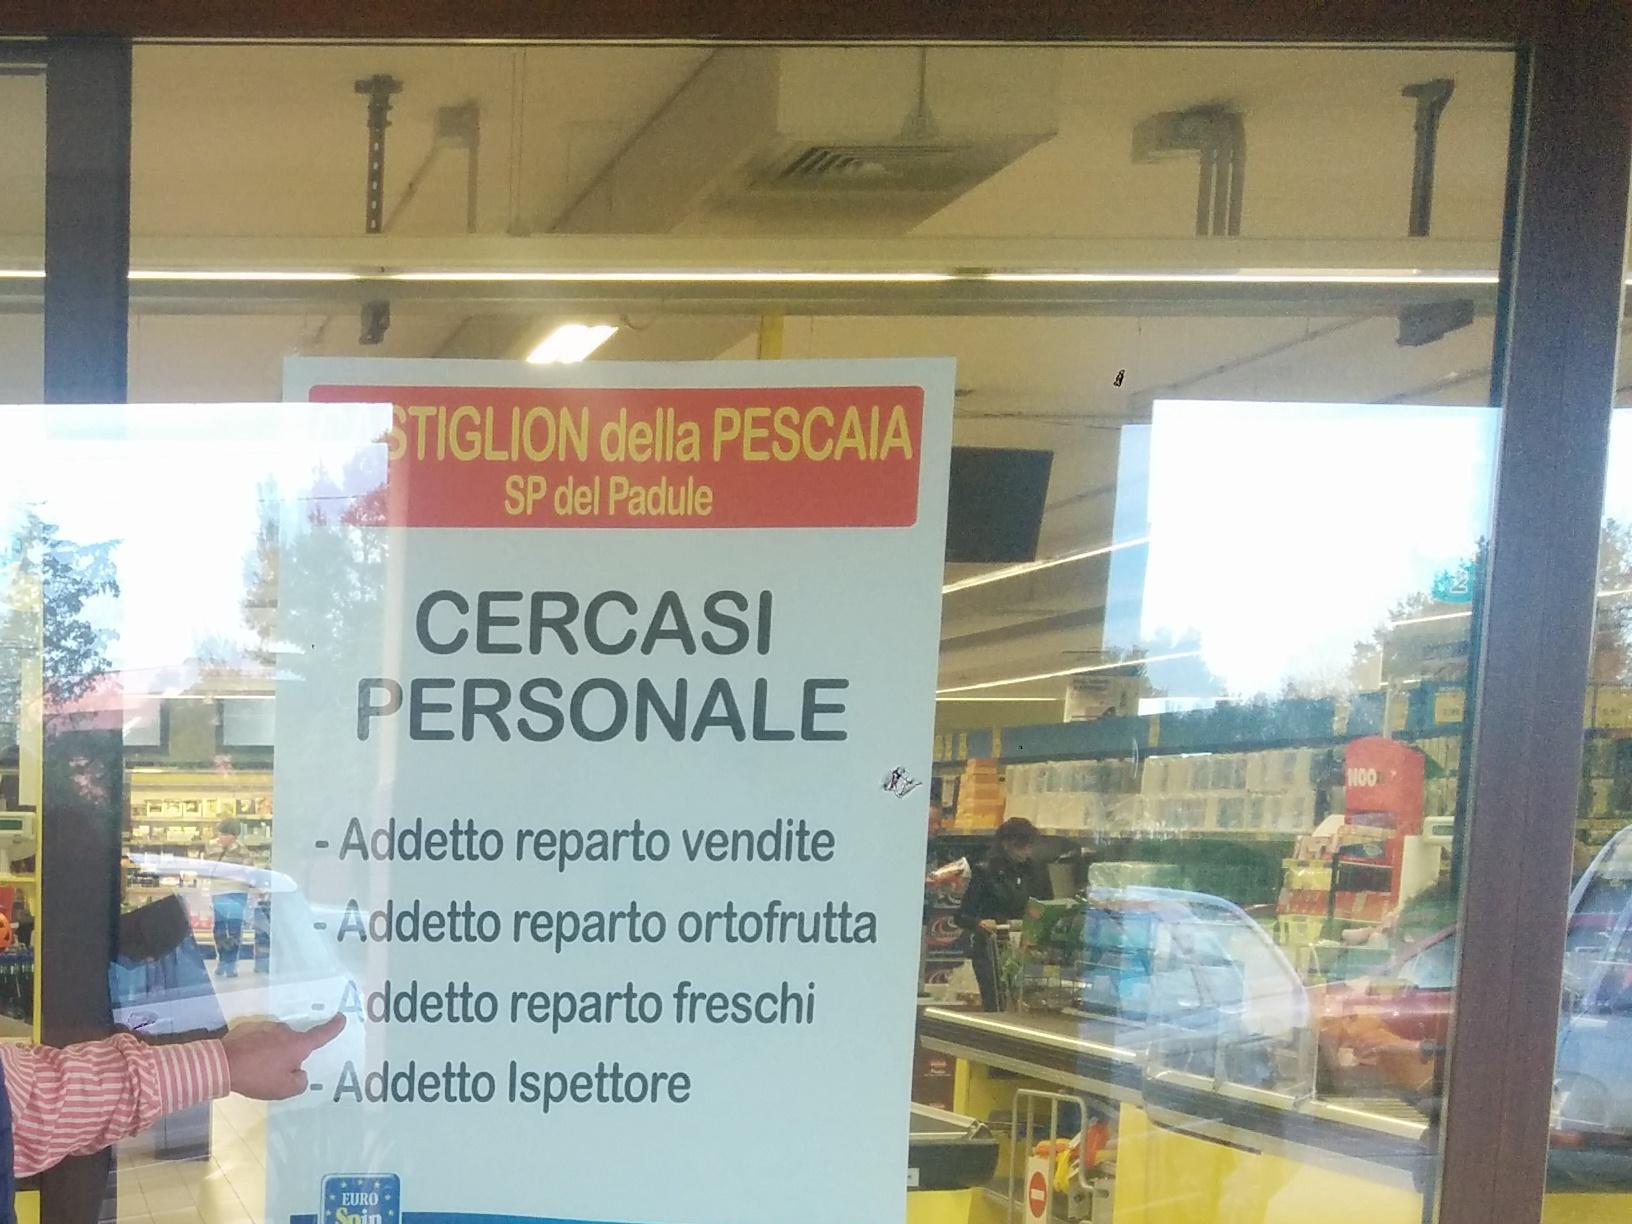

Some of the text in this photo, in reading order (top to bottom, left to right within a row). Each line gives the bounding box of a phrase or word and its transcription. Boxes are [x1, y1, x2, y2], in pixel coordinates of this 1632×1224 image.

[389, 404, 913, 463] STIGLION della PESCAIA
[504, 475, 714, 517] SP del Padule
[415, 589, 773, 656] CERCASI
[356, 676, 850, 742] PERSONALE
[338, 817, 504, 863] Addetto
[515, 821, 670, 872] reparto
[682, 818, 836, 864] vendite
[336, 899, 501, 945] Addetto
[512, 902, 667, 953] reparto
[678, 900, 879, 946] ortofrutta
[337, 980, 498, 1023] Addetto
[509, 983, 664, 1033] reparto
[673, 981, 816, 1025] freschi
[333, 1060, 496, 1104] Addetto
[508, 1060, 691, 1112] Ispettore
[342, 1192, 379, 1206] EURO
